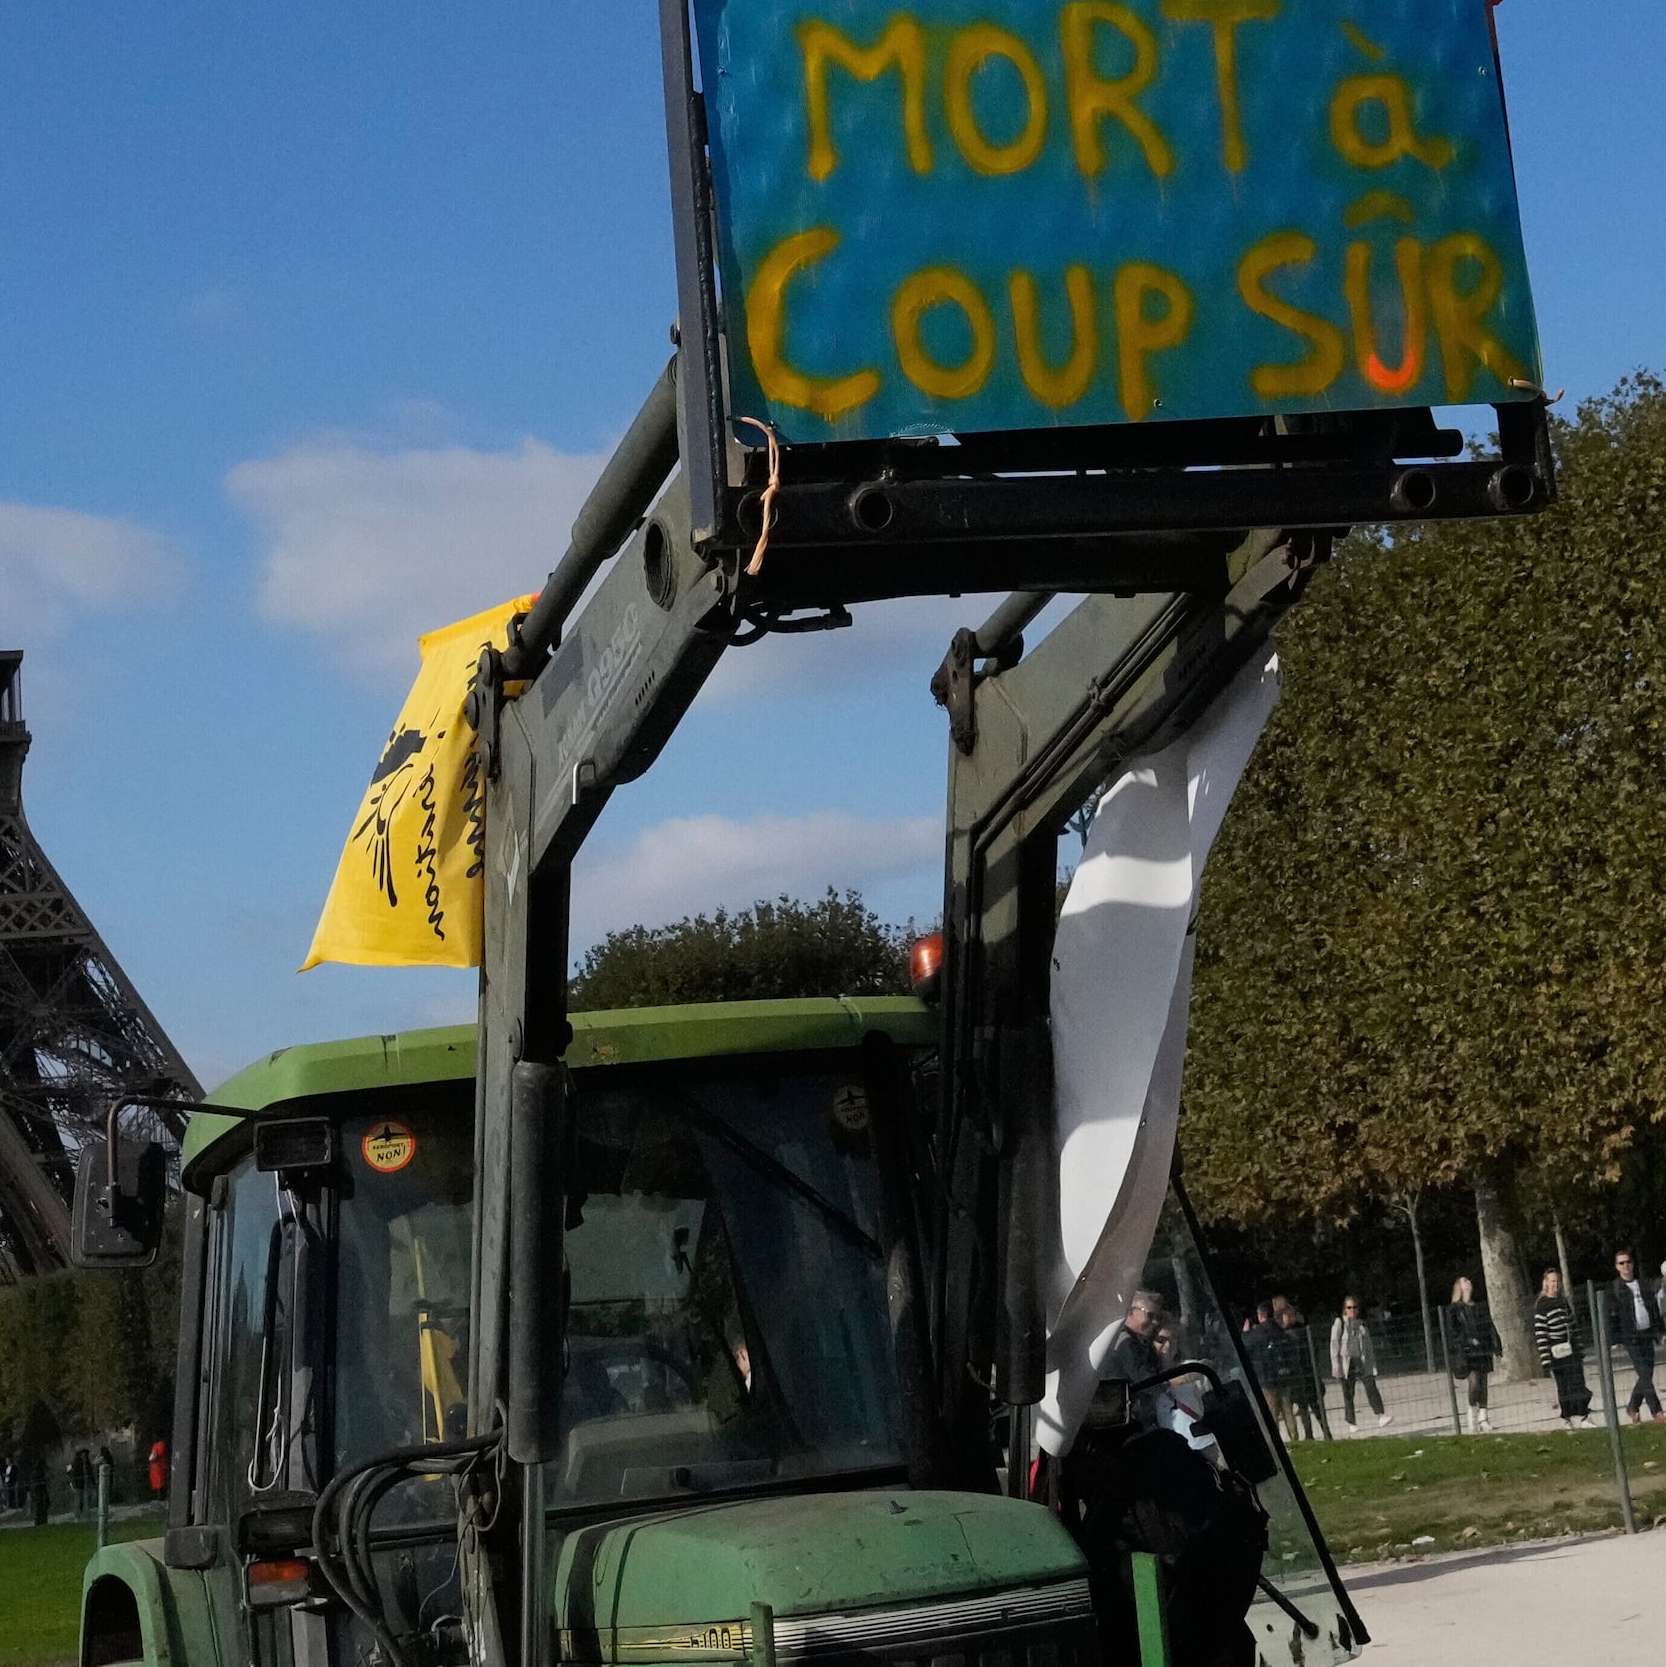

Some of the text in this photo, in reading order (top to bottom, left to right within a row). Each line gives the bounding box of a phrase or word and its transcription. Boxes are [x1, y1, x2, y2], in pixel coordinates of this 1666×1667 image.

[1328, 20, 1459, 174] à
[745, 191, 1533, 419] COUP SÛR
